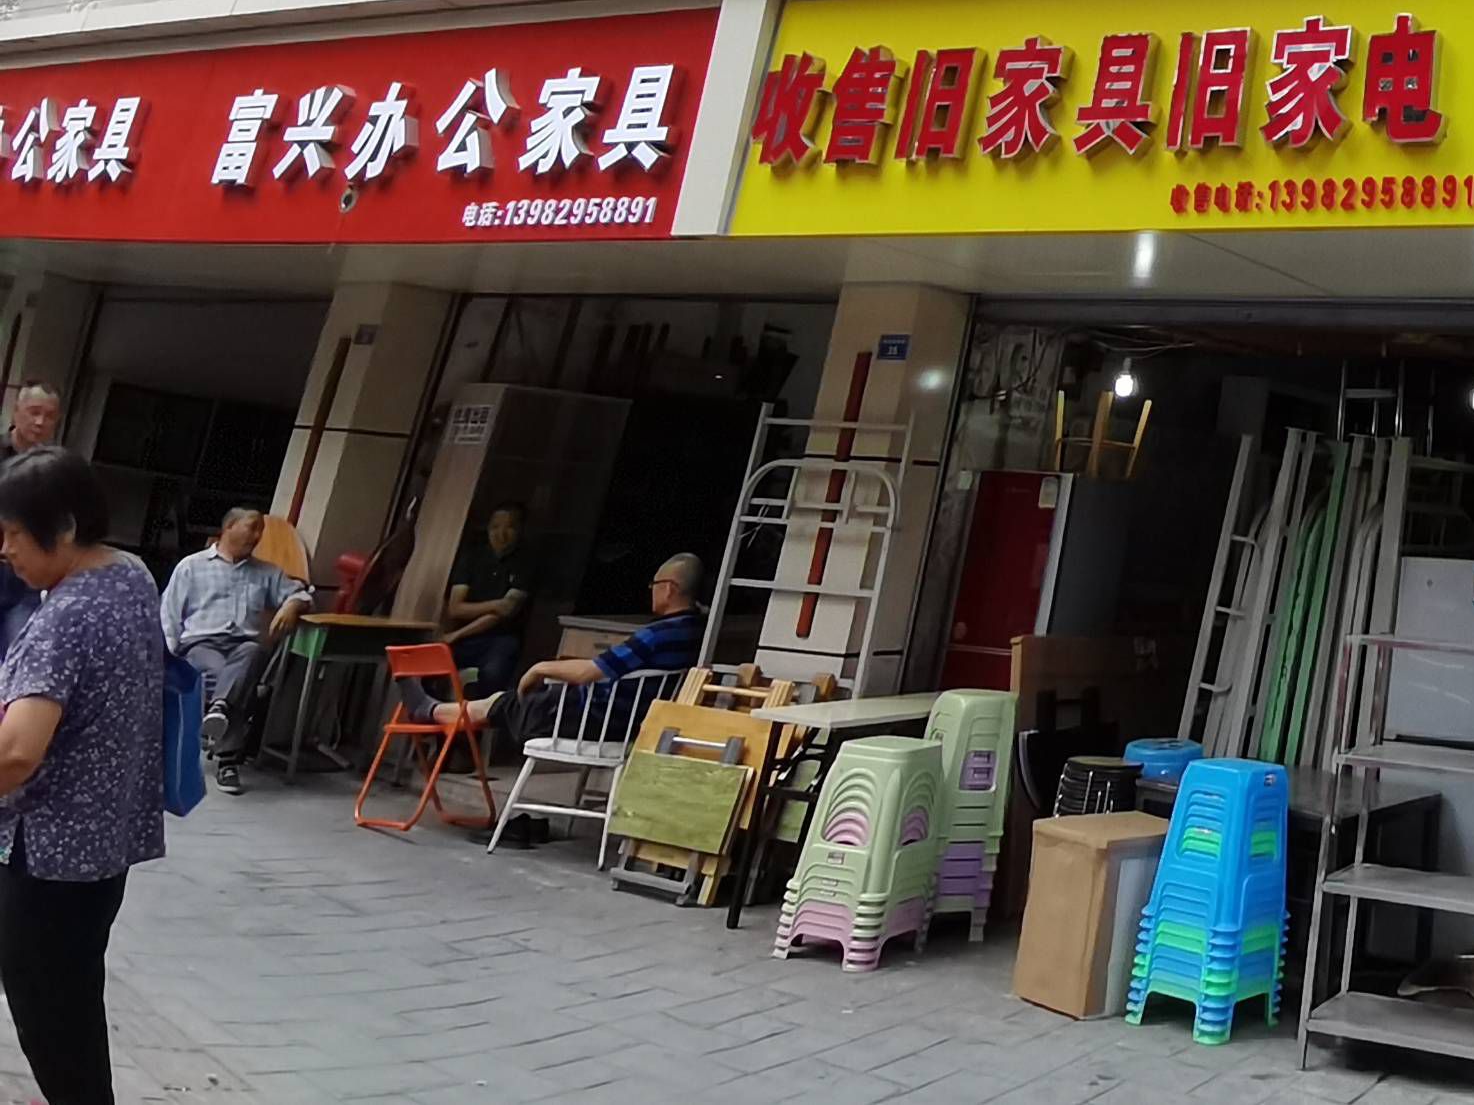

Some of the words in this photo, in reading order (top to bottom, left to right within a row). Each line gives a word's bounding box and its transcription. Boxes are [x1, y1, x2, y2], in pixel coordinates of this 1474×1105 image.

[0, 96, 141, 183] 公家具
[211, 63, 676, 186] 富兴办公家具
[750, 13, 1448, 167] 收售旧家具旧家电
[462, 197, 657, 227] 电话:13982958891
